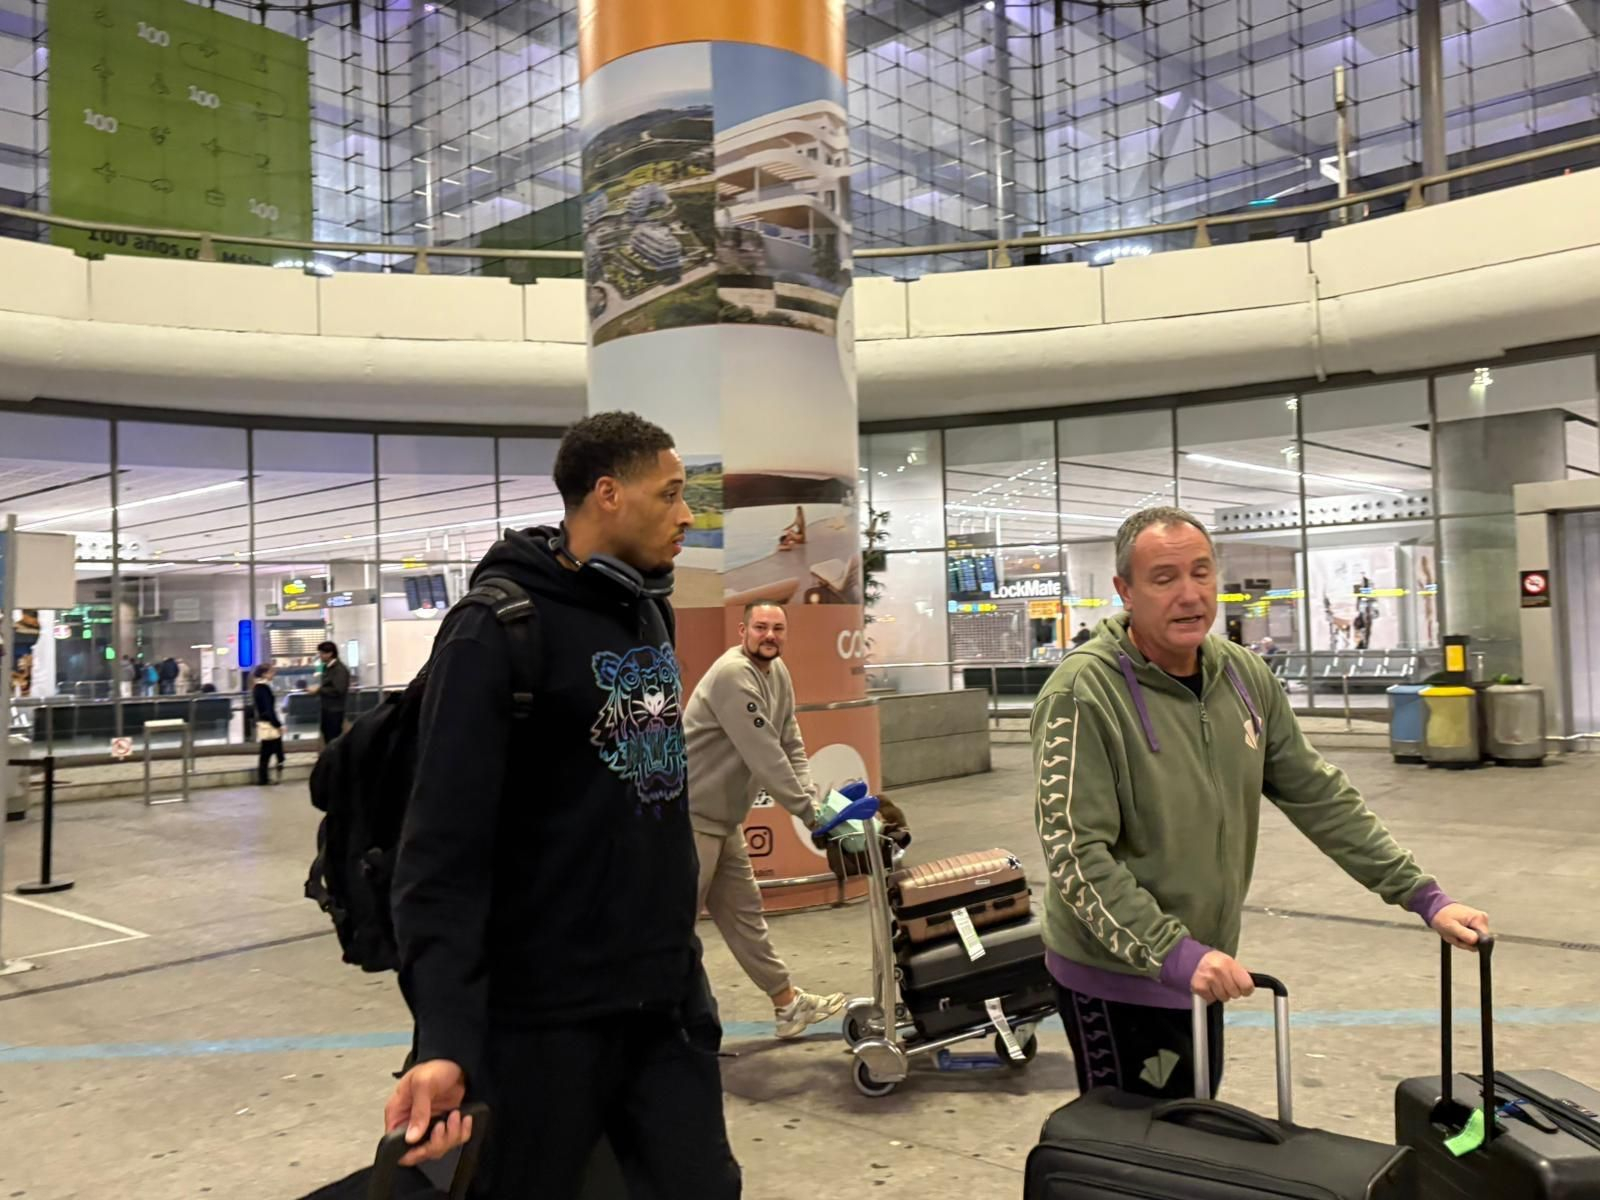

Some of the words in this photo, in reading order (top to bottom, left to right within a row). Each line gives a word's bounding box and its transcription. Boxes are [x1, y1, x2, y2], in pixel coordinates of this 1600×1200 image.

[137, 21, 170, 47] 100
[188, 85, 220, 109] 100
[83, 108, 118, 133] 100
[249, 198, 279, 221] 100
[990, 579, 1061, 598] LockMate
